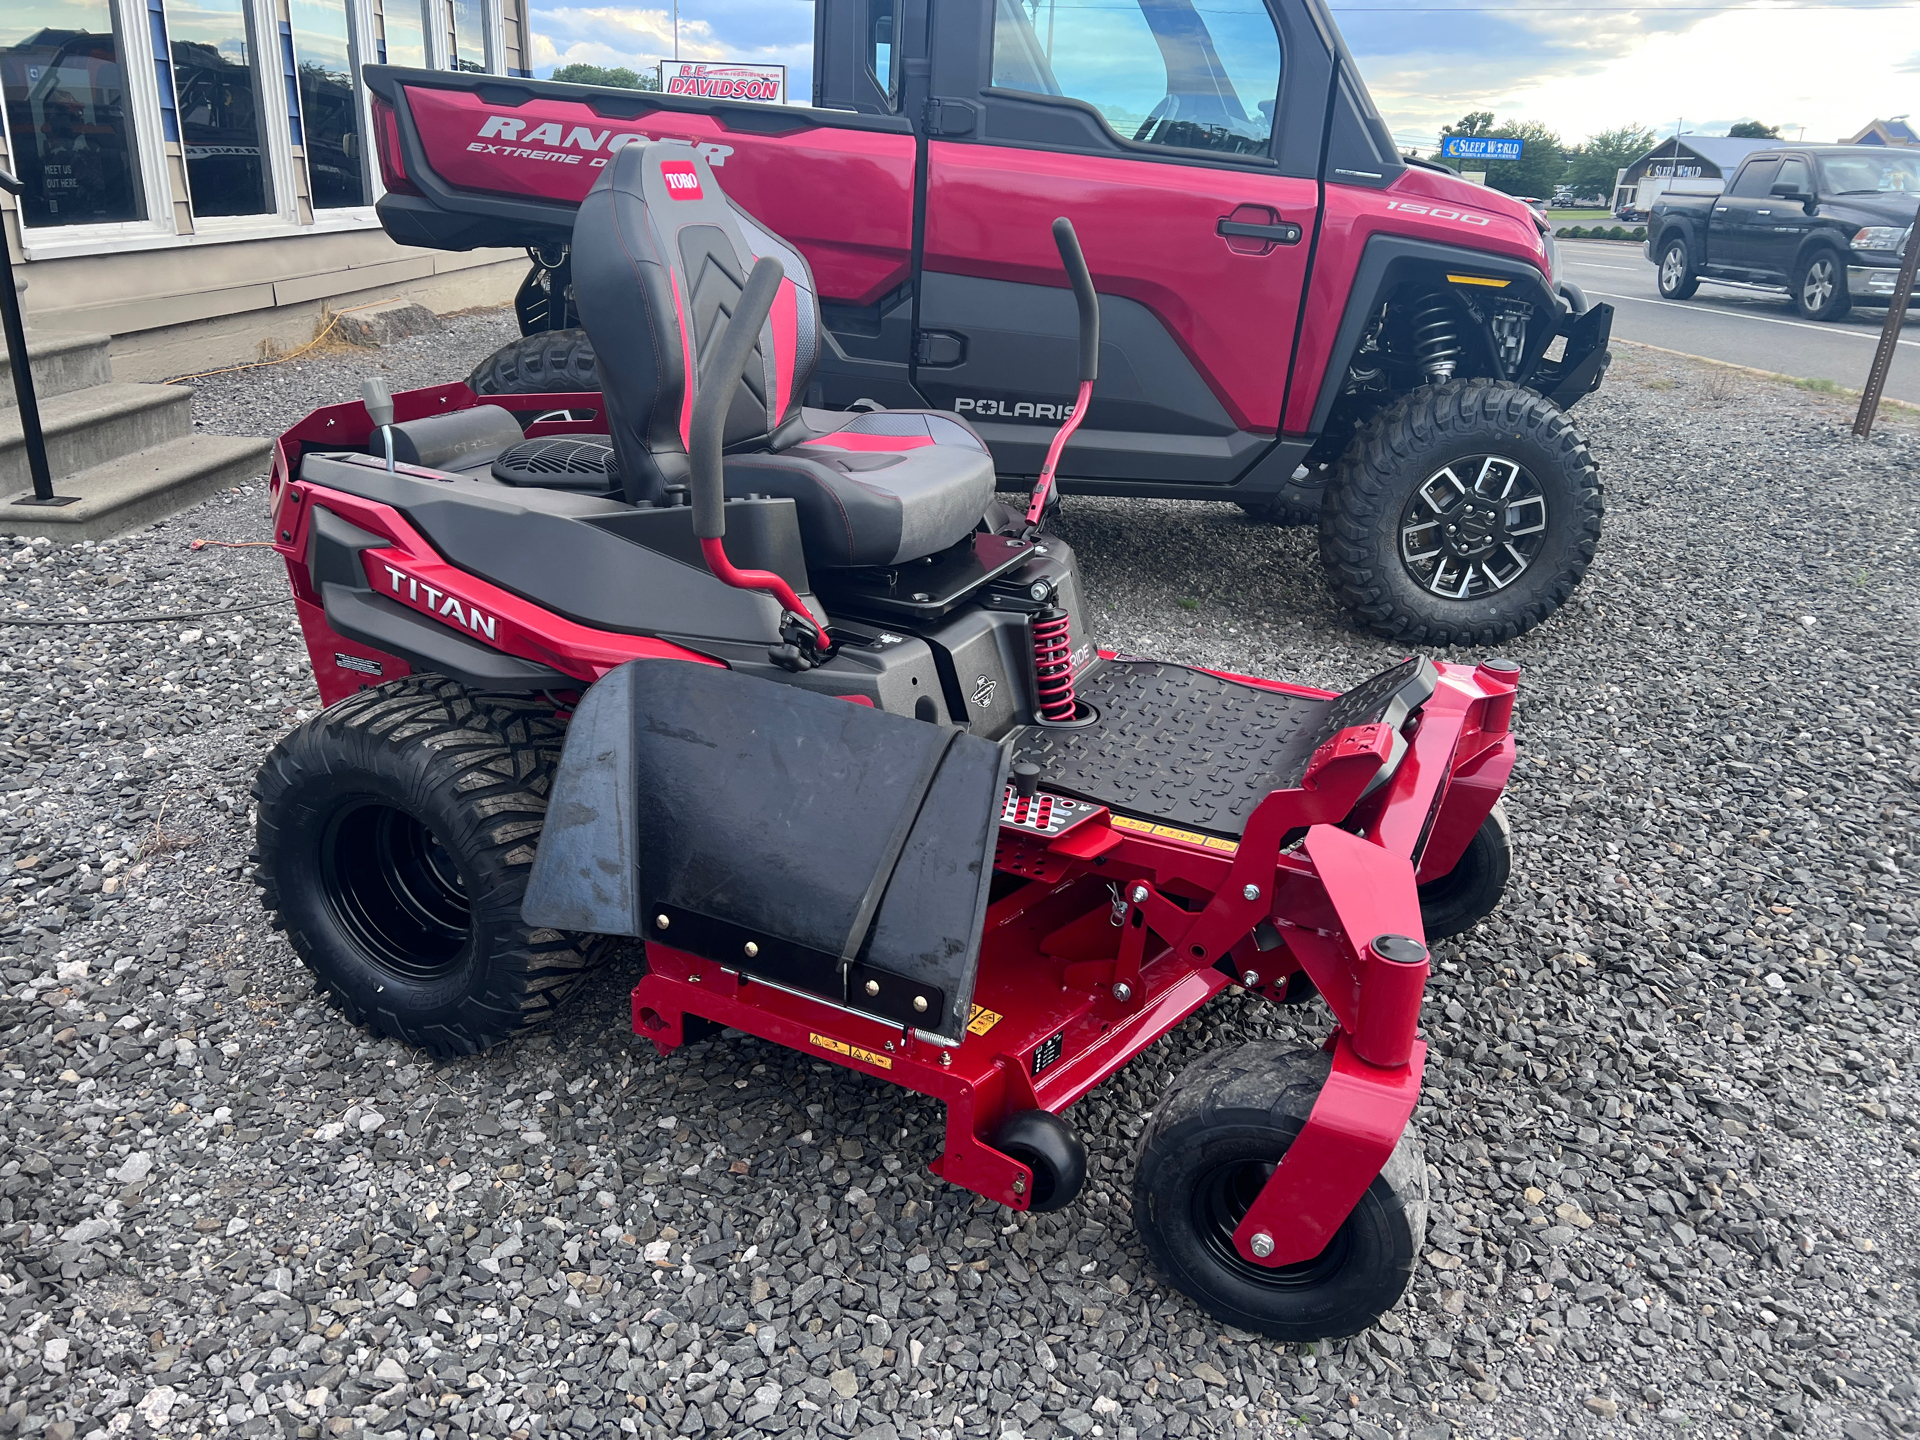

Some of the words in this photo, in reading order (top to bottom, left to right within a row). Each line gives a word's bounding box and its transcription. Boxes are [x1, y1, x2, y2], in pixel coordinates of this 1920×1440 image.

[712, 70, 780, 79] www.redavidson.com
[668, 77, 780, 100] DAVIDSON
[466, 142, 584, 165] EXTREME
[1459, 139, 1486, 152] SLEEP
[1487, 140, 1519, 154] WORLD
[44, 164, 61, 174] MEET
[62, 164, 72, 174] US
[1654, 165, 1676, 177] SLEEP
[47, 178, 59, 188] OUT
[666, 172, 698, 189] TORO
[1386, 200, 1490, 226] 1500
[954, 397, 1076, 420] POLARIS
[384, 564, 496, 640] TITAN
[1064, 643, 1090, 668] RIDE
